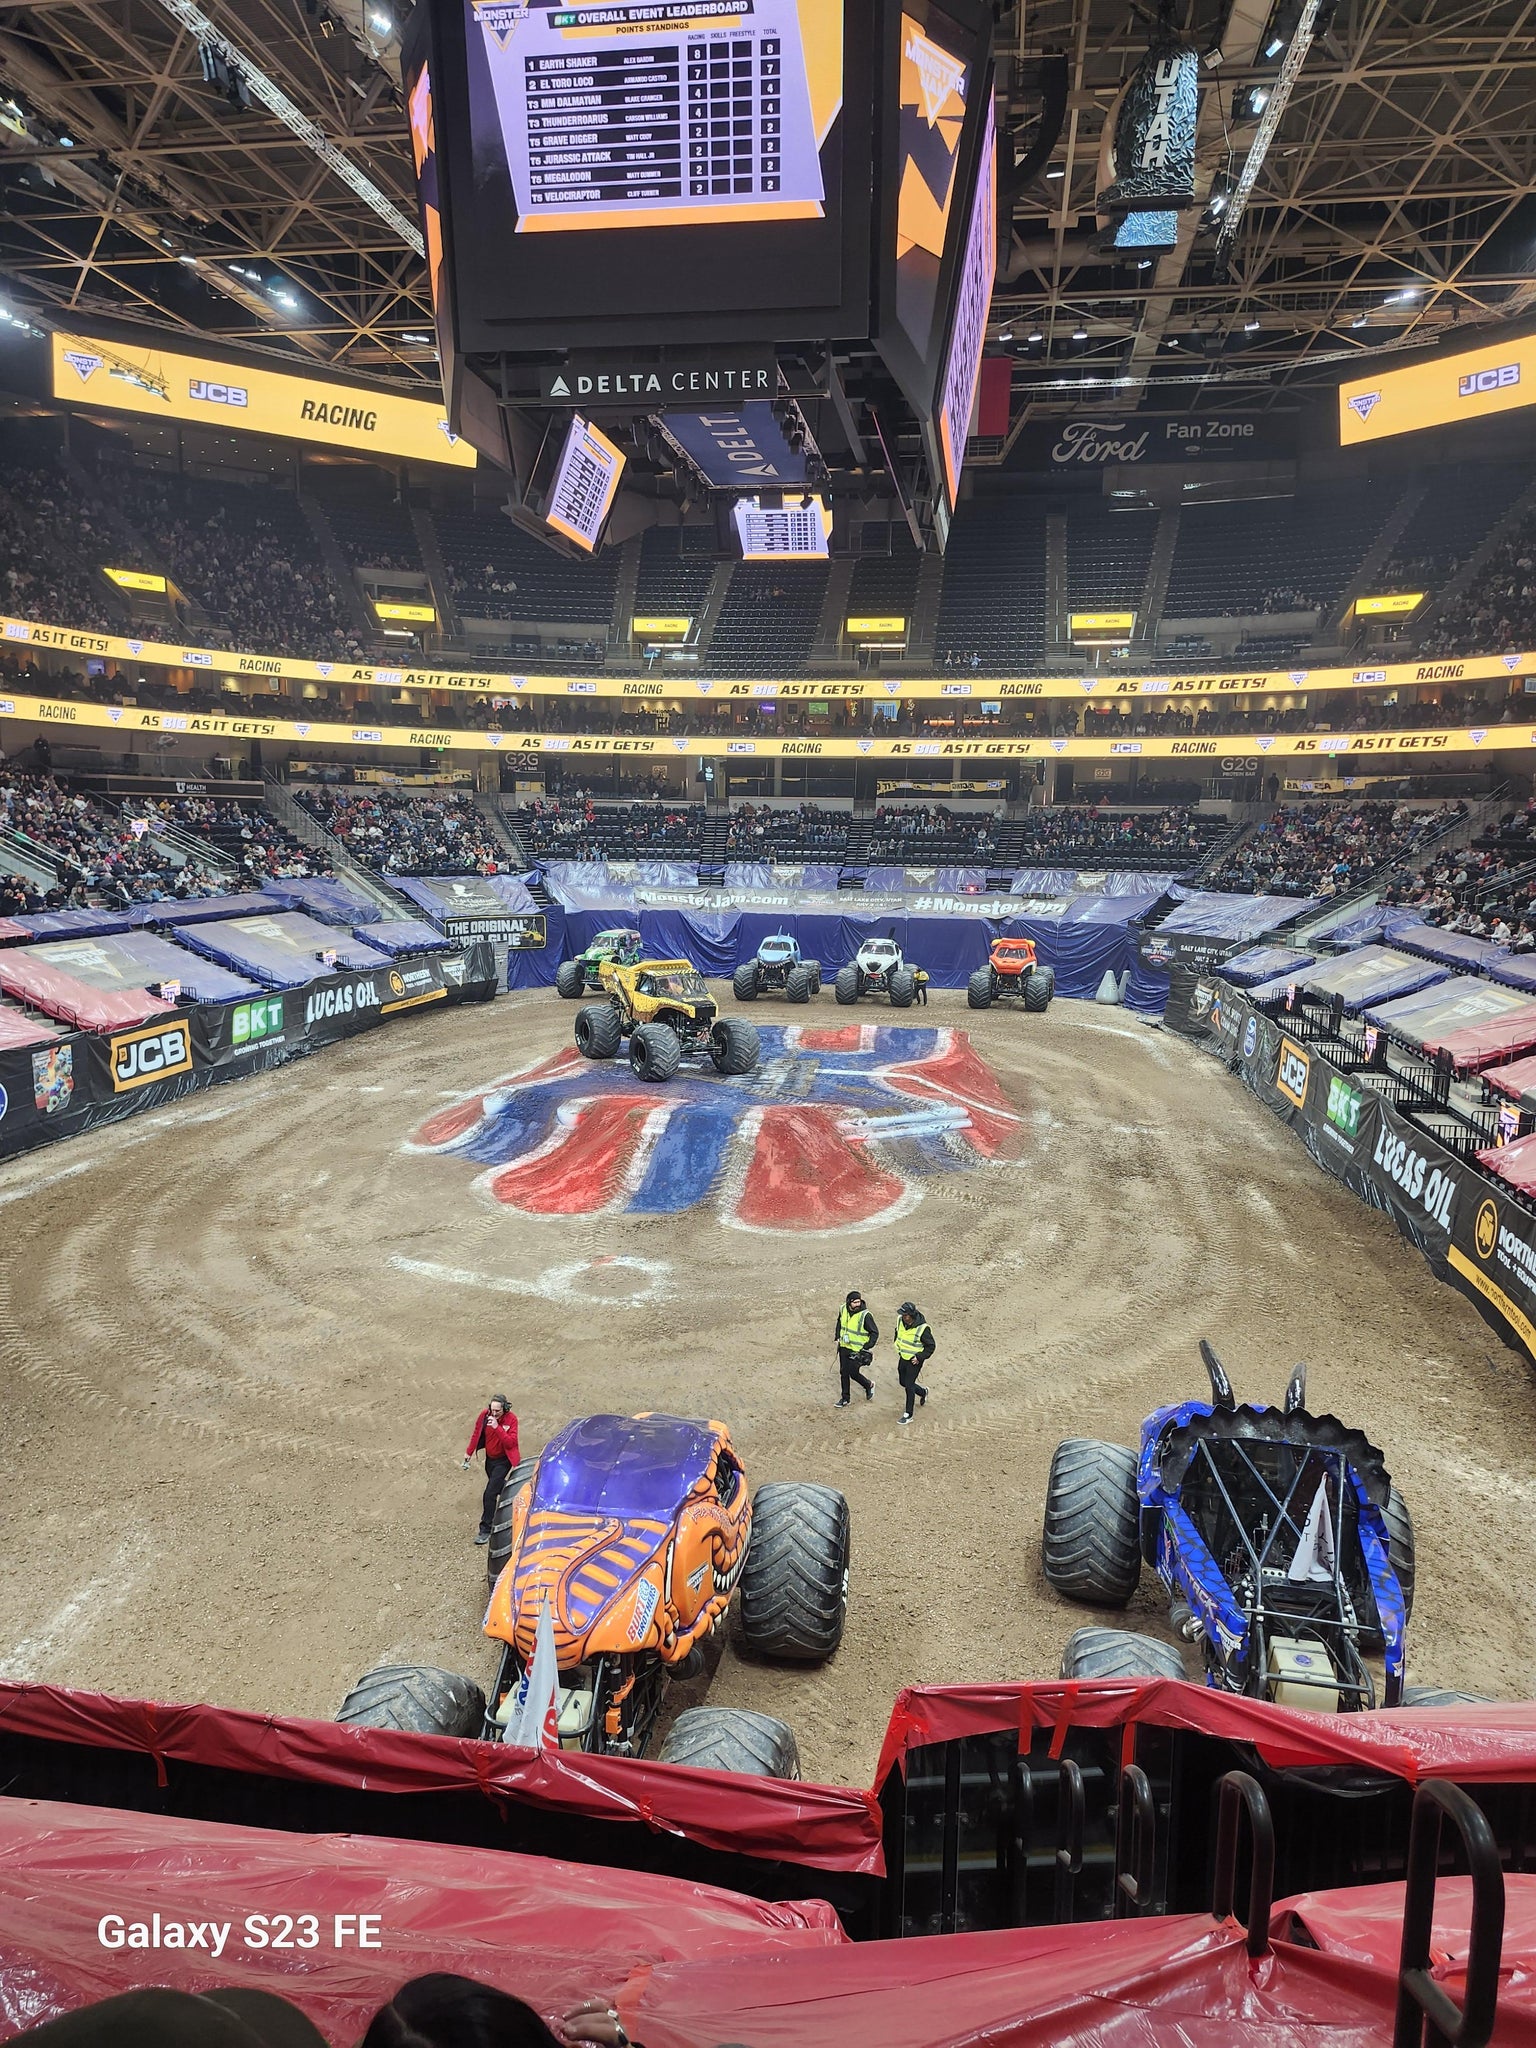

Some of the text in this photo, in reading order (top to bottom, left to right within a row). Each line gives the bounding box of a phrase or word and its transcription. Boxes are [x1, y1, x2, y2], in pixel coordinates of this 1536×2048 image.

[473, 8, 529, 21] MONSTER
[578, 10, 626, 24] OVERALL
[629, 7, 664, 20] EVENT
[666, 1, 748, 17] LEADERBOARD
[490, 20, 515, 30] JAM
[616, 22, 689, 34] POINTS STANDINGS
[694, 44, 773, 59] 8 8
[528, 61, 534, 70] 1
[539, 58, 564, 70] EARTH
[566, 57, 598, 68] SHAKER
[694, 64, 773, 79] 7 7
[528, 80, 536, 90] 2
[540, 79, 550, 89] EL
[552, 78, 572, 88] TORO
[574, 76, 594, 87] LOCO
[694, 84, 773, 98] 4 4
[541, 98, 556, 108] MM
[557, 95, 602, 107] DALMATIAN
[695, 103, 774, 118] 4 4
[1141, 58, 1178, 169] UTAH
[542, 114, 608, 128] THUNDERROARUS
[696, 123, 774, 137] 2 2
[542, 135, 568, 146] GRAVE
[570, 134, 598, 144] DIGGER
[696, 142, 774, 156] 2 2
[543, 153, 581, 164] JURASSIC
[582, 152, 611, 162] ATTACK
[696, 161, 774, 174] 2 2
[544, 172, 592, 183] MEGALODON
[696, 180, 774, 194] 2 2
[544, 190, 600, 202] VELOCIRAPTOR
[577, 370, 769, 395] DELTA CENTER
[1459, 364, 1519, 396] JCB
[190, 380, 248, 407] JCB
[300, 399, 378, 432] RACING
[1166, 421, 1254, 439] Fan Zone
[1052, 422, 1149, 463] Ford
[6, 623, 29, 639] BIG
[32, 629, 50, 641] AS
[53, 632, 67, 644] IT
[71, 635, 108, 651] GETS!
[183, 652, 212, 665] JCB
[239, 658, 281, 673] RACING
[352, 670, 491, 688] AS BIG AS IT GETS!
[1353, 671, 1386, 683] JCB
[1416, 664, 1464, 680] RACING
[567, 682, 596, 692] JCB
[623, 683, 663, 695] RACING
[730, 684, 864, 695] AS BIG AS IT GETS!
[941, 684, 971, 694] JCB
[999, 684, 1043, 695] RACING
[1116, 677, 1267, 693] AS BIG AS IT GETS!
[39, 704, 76, 720] RACING
[141, 715, 275, 735] AS BIG AS IT GETS!
[352, 730, 382, 741] JCB
[410, 733, 452, 745] RACING
[521, 738, 654, 751] AS BIG AS IT GETS!
[727, 743, 755, 752] JCB
[781, 742, 822, 754] RACING
[891, 744, 1031, 754] AS BIG AS IT GETS!
[1110, 743, 1142, 753] JCB
[1171, 742, 1217, 754] RACING
[1294, 735, 1448, 751] AS BIG AS IT GETS!
[504, 752, 539, 766] G2G
[1221, 757, 1258, 771] G2G
[639, 890, 789, 909] MonsterJam.com
[912, 896, 1069, 916] #MonsterJam
[448, 919, 527, 935] THE ORIGINAL
[1194, 946, 1207, 954] LAKE
[1219, 949, 1233, 957] UTAH
[306, 985, 353, 1023] LUCAS
[233, 1002, 282, 1037] BKT
[234, 1035, 286, 1056] GROWING TOGETHER
[117, 1031, 186, 1079] JCB
[1281, 1052, 1307, 1096] JCB
[1327, 1083, 1361, 1128] BKT
[1373, 1124, 1427, 1200] LUCAS
[1497, 1248, 1511, 1270] TOOL
[637, 1583, 658, 1642] BROTHERS
[626, 1600, 645, 1641] BURT
